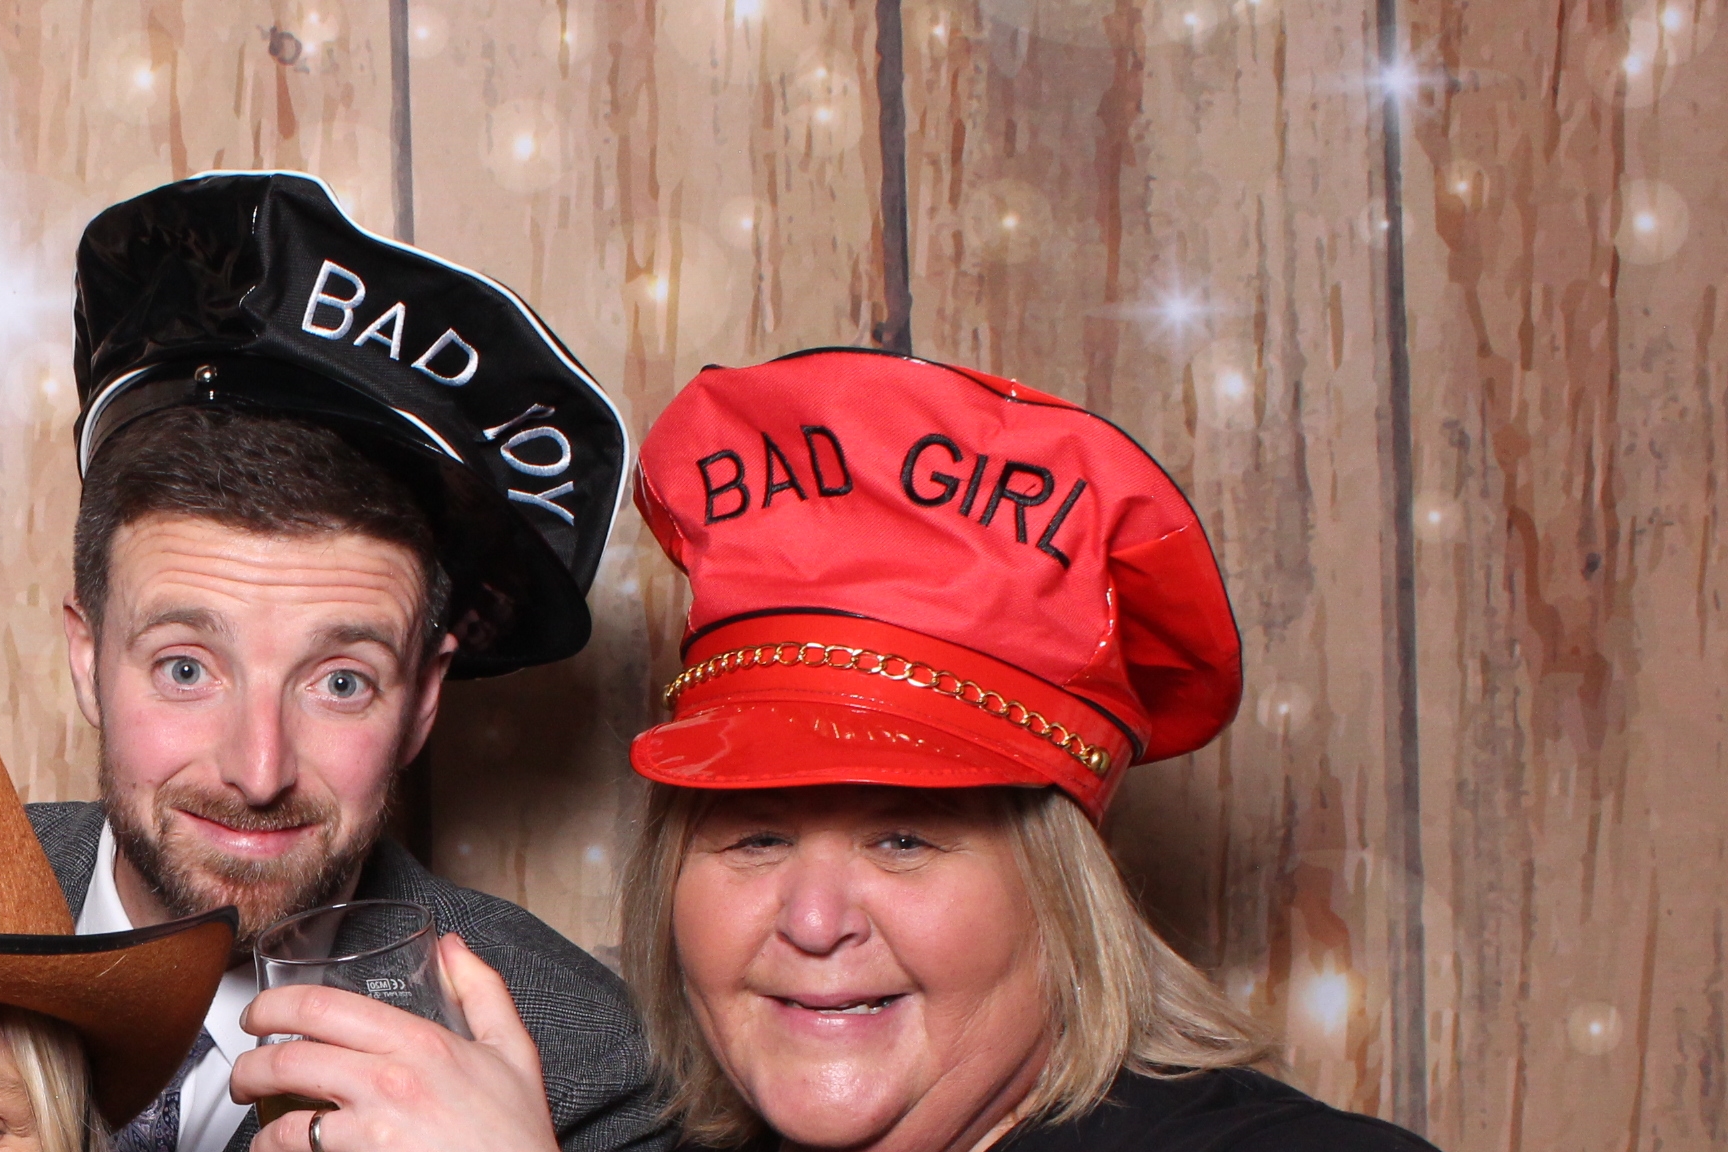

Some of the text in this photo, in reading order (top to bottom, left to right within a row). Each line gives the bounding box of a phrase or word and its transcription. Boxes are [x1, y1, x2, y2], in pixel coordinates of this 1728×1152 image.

[301, 259, 479, 386] BAD
[697, 425, 1088, 569] BAD GIRL
